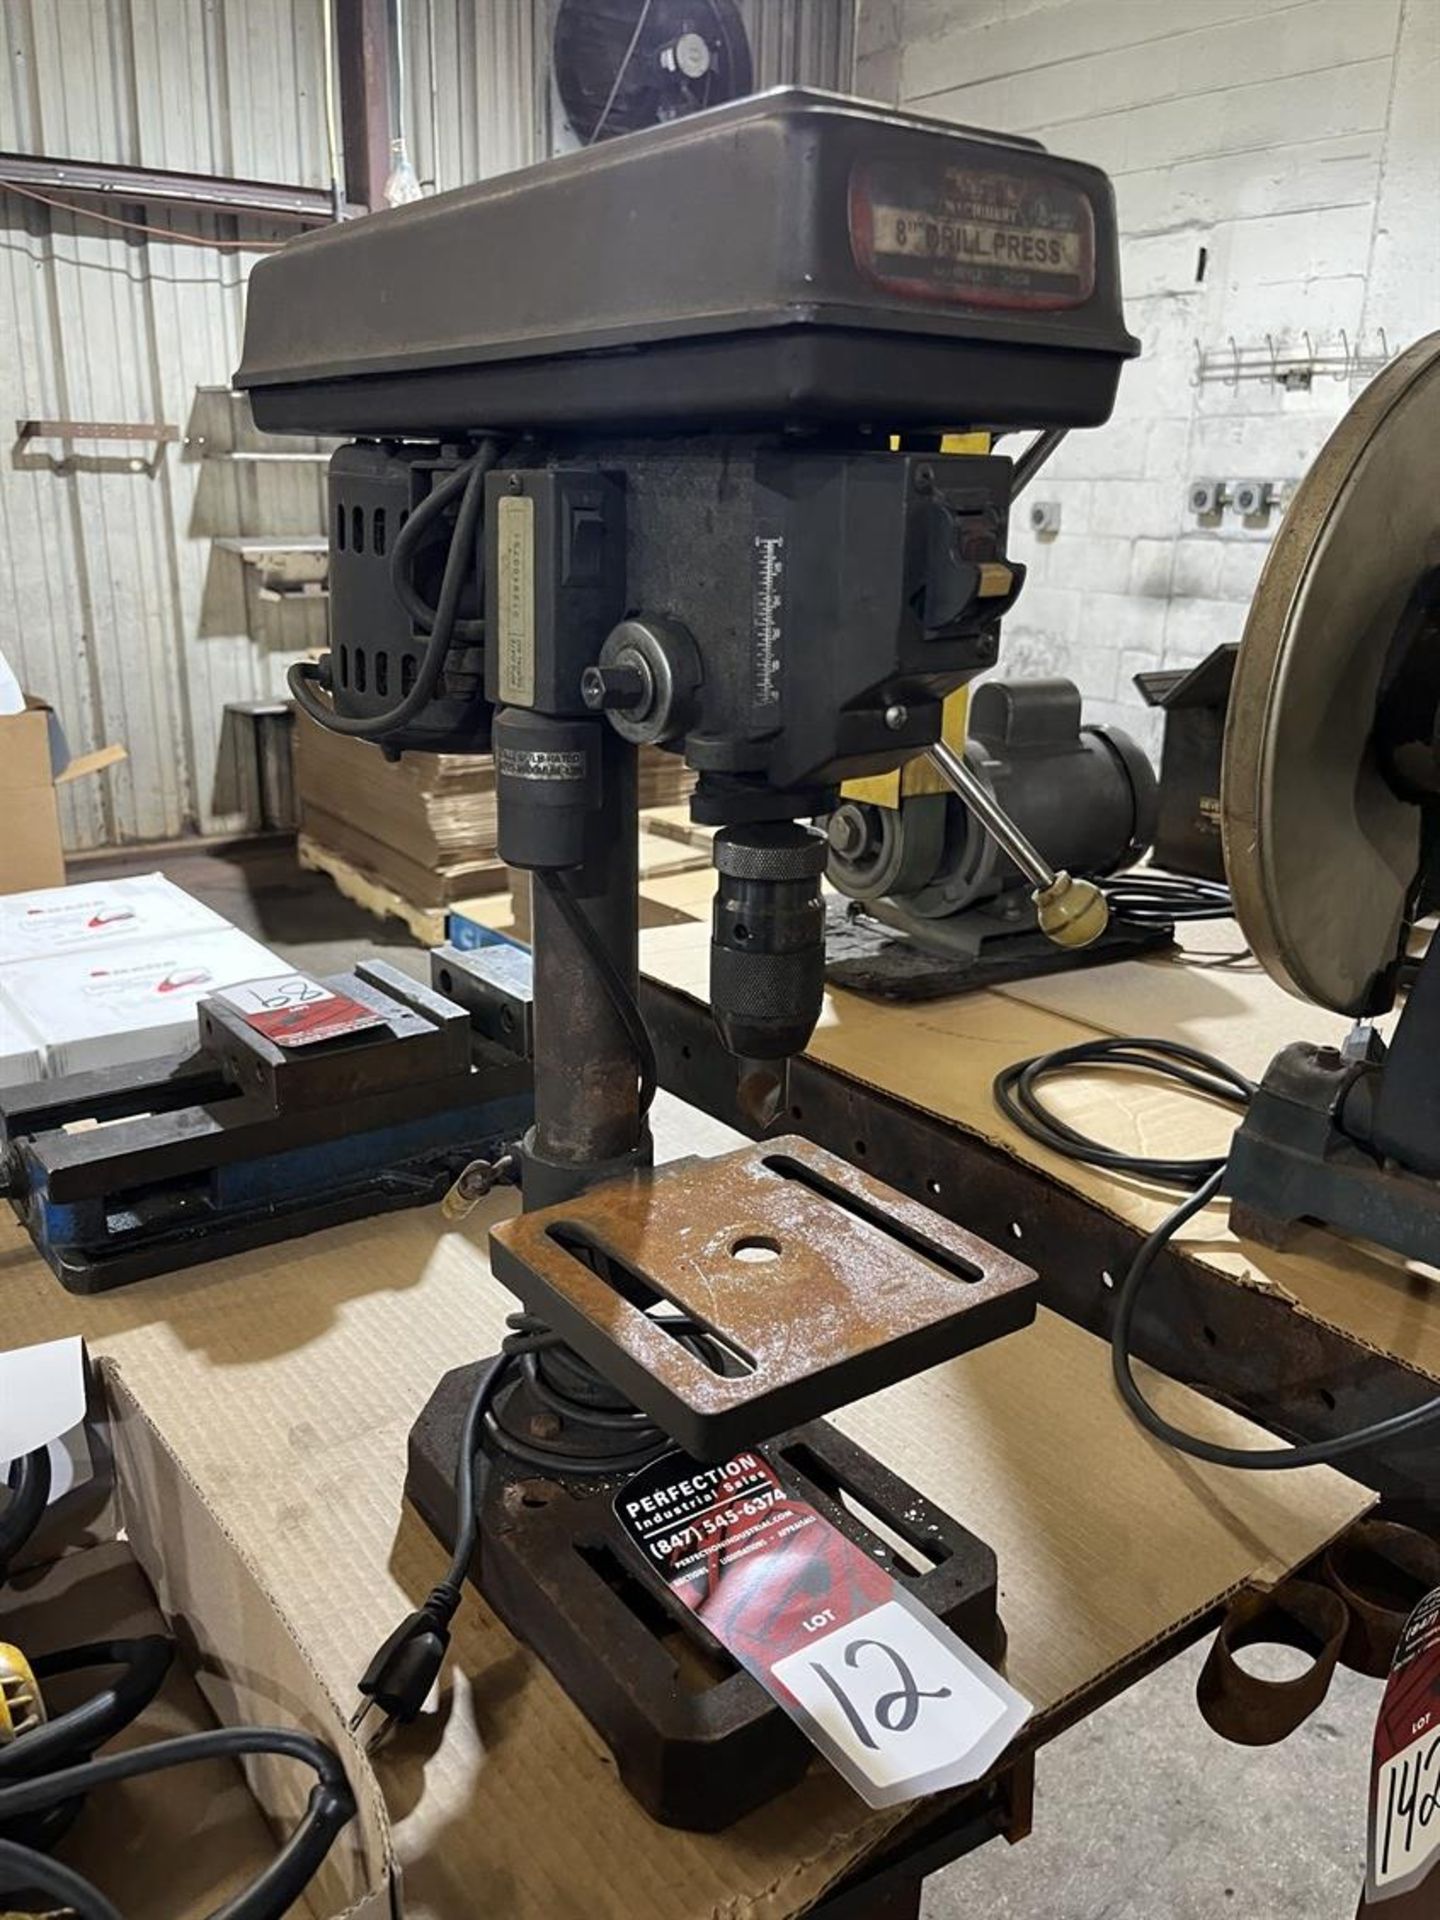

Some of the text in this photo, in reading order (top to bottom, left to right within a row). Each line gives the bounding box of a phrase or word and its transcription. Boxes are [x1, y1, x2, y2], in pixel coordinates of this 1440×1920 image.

[926, 224, 992, 257] DRILL
[992, 235, 1062, 265] PRESS
[626, 1454, 758, 1519] PERFECTION
[634, 1470, 767, 1532] Industrial Sales
[650, 1487, 788, 1560] (847) 545-6374
[675, 1510, 795, 1569] PERFECTIONINDUSTRIAL.COM
[802, 1609, 837, 1633] LOT
[808, 1638, 953, 1751] 12
[1411, 1712, 1432, 1735] LOT
